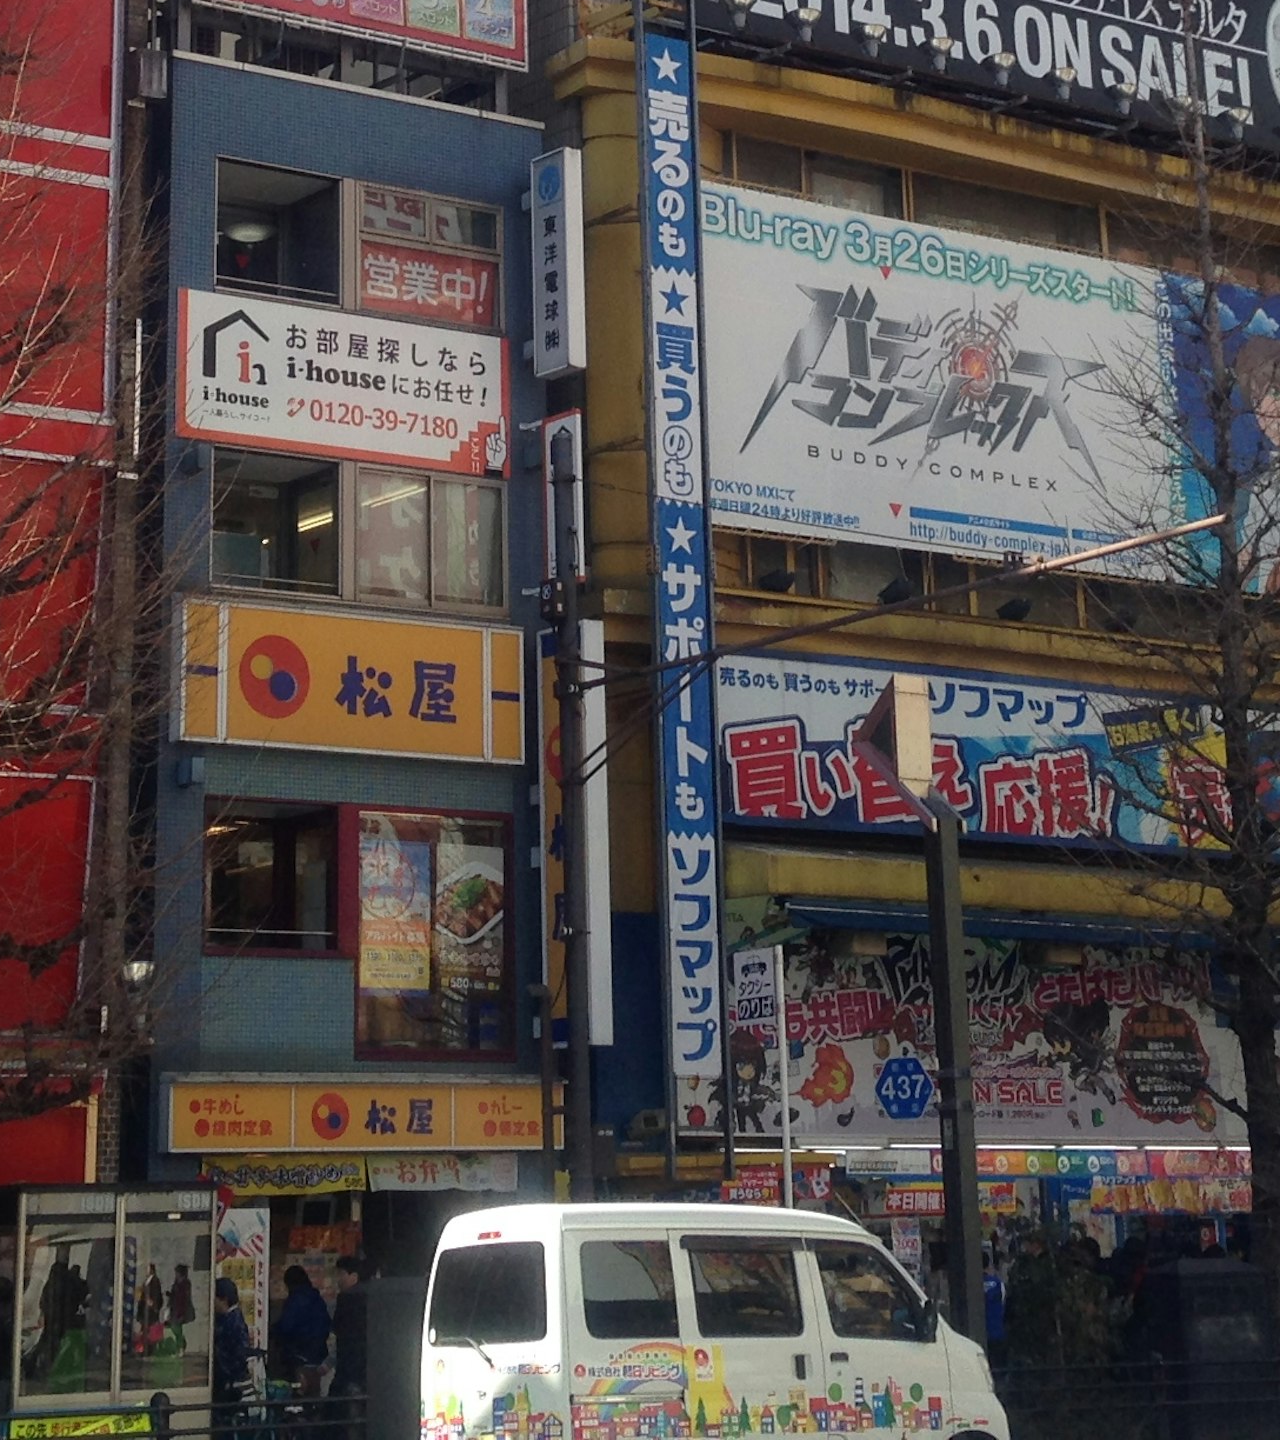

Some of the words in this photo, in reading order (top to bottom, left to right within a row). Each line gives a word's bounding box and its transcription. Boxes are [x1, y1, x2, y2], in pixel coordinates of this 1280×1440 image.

[1014, 4, 1093, 90] ON
[647, 88, 691, 259] 売るのも
[701, 192, 837, 261] Blu-ray
[362, 251, 487, 315] 営業中!
[285, 323, 488, 377] お部屋探しなら
[391, 371, 488, 408] にお任せ!
[655, 321, 697, 498] 買うのも
[308, 397, 459, 440] 0120-39-7180
[807, 444, 909, 471] BUDDY
[928, 462, 1059, 492] COMPLEX
[334, 654, 459, 725] 松屋
[720, 665, 780, 689] 売るのも
[783, 672, 841, 695] 買うのも
[670, 846, 718, 1064] ソフマップ
[737, 998, 775, 1021] のりば
[738, 980, 773, 997] タクシー
[880, 1074, 926, 1101] 437
[997, 1078, 1063, 1105] SALE
[364, 1097, 434, 1136] 松屋
[177, 1191, 212, 1211] ISDN
